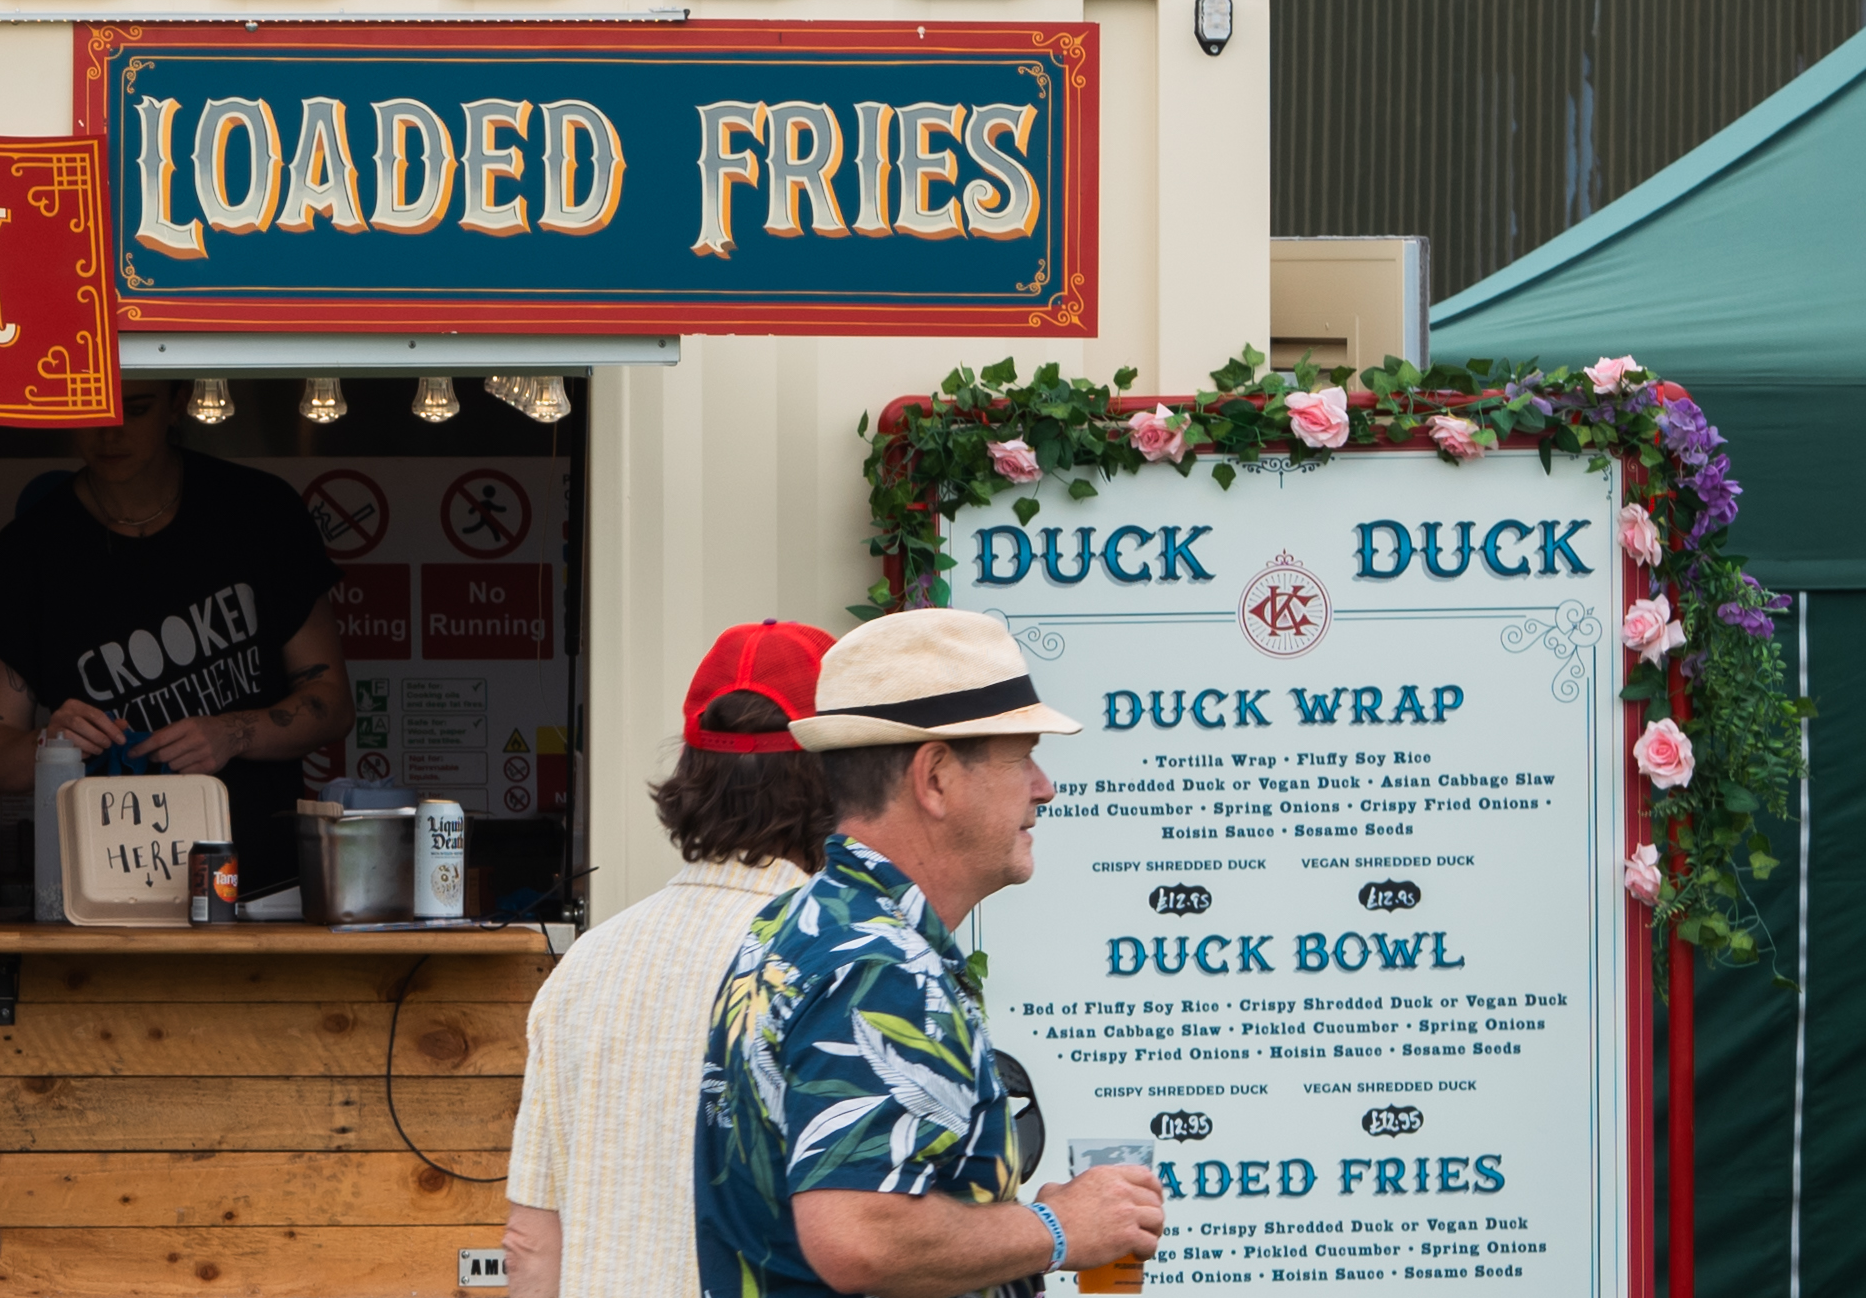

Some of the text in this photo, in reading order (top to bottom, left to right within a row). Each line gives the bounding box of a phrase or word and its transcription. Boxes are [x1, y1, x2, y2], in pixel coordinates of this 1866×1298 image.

[134, 92, 1042, 261] LOADED FRIES
[972, 519, 1594, 586] DUCK DUCK
[469, 582, 506, 603] No
[77, 583, 258, 701] CROOKED
[429, 614, 546, 641] Running
[1104, 685, 1464, 730] DUCK WRAP
[106, 840, 187, 880] HERE
[1108, 932, 1465, 976] DUCK BOWL
[1071, 1041, 1521, 1064] Crispy Fried Onions Hoisin Sauce Sesame Seeds
[1157, 1155, 1505, 1199] ADED FRIES
